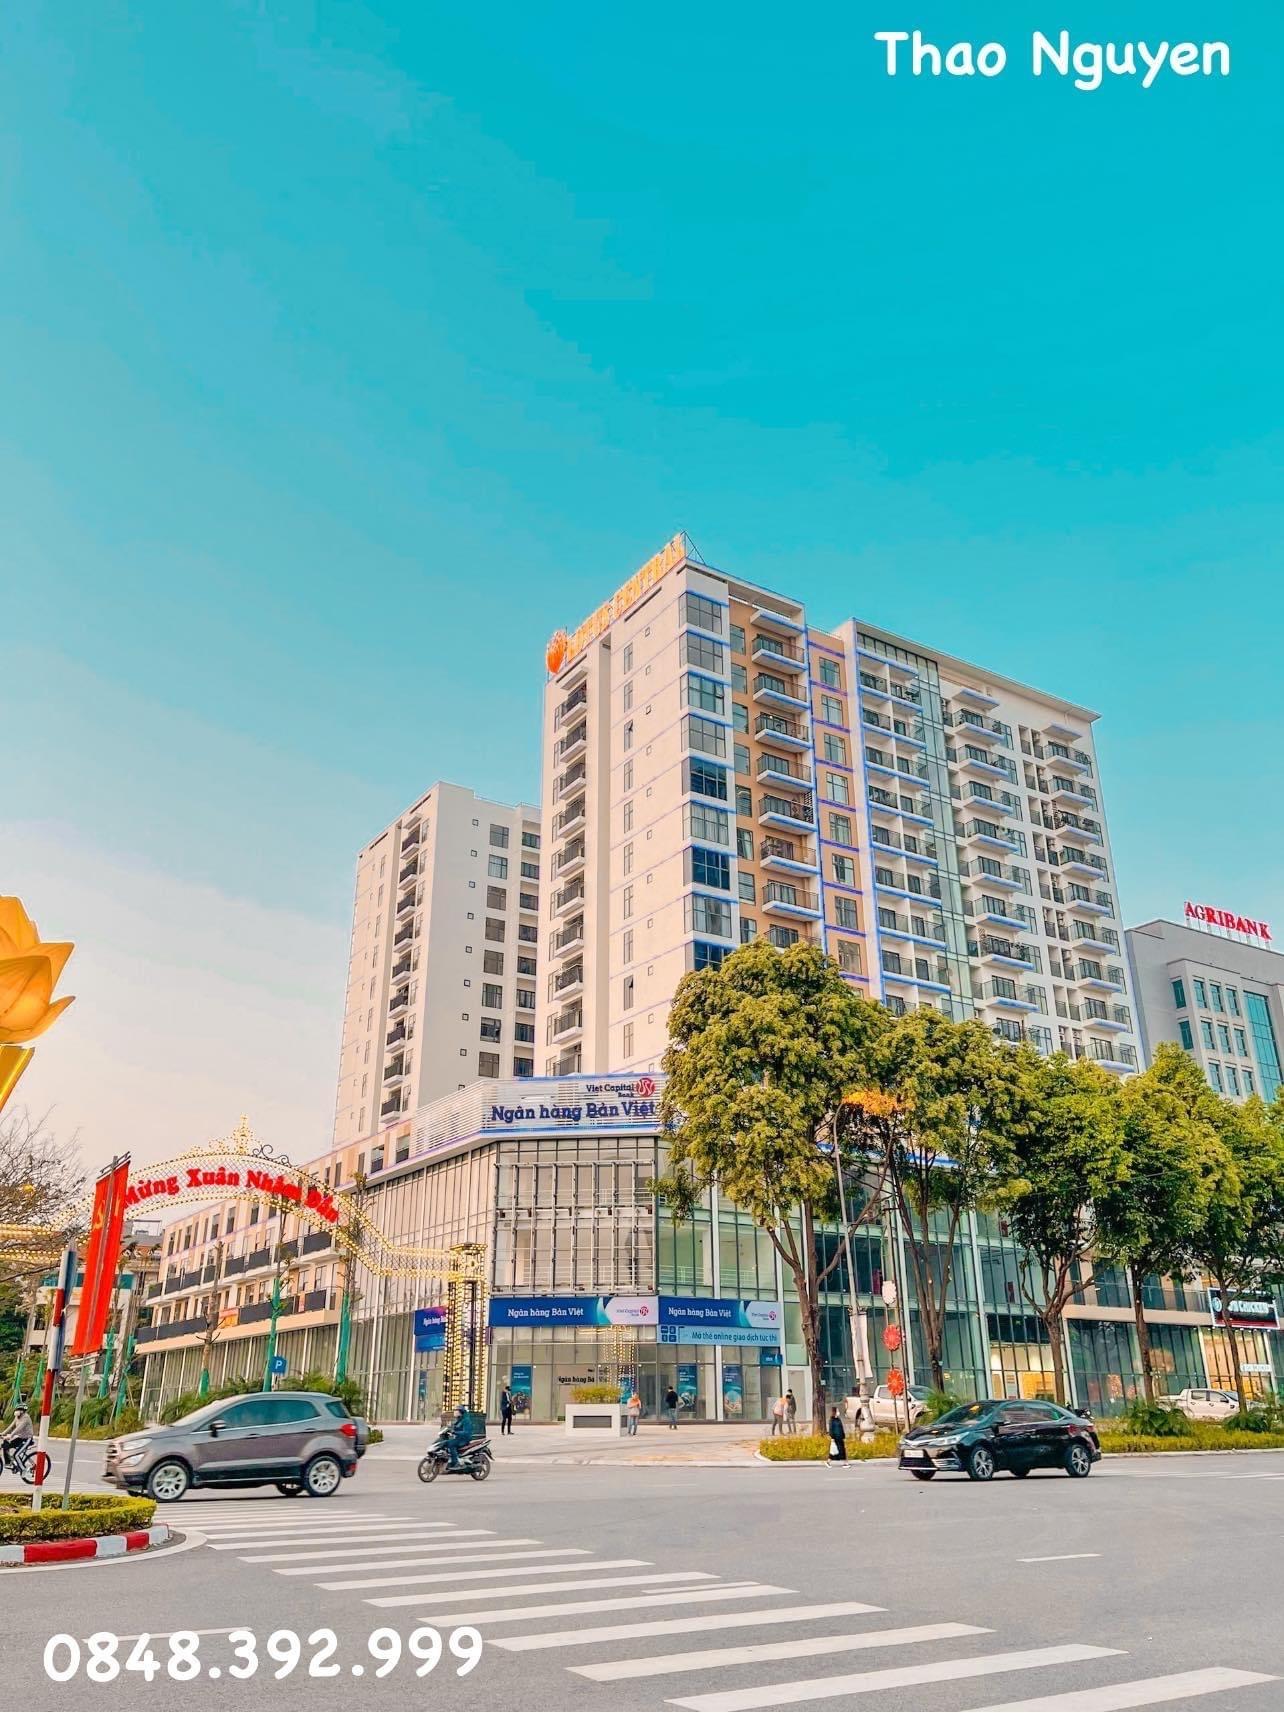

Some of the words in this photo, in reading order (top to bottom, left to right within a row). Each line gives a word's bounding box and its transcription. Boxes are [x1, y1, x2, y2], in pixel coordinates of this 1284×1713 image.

[1184, 901, 1272, 940] AGRIBANK
[604, 1083, 634, 1093] Capital
[491, 1105, 535, 1124] Ngân
[539, 1104, 582, 1122] hàng
[586, 1102, 619, 1118] Bản
[621, 1101, 656, 1119] Việt
[186, 1166, 239, 1188] Xuân
[507, 1308, 528, 1318] Ngân
[530, 1308, 550, 1318] hàng
[551, 1307, 567, 1316] Bản
[568, 1307, 584, 1317] Việt
[668, 1307, 686, 1317] Ngân
[687, 1307, 704, 1318] hàng
[719, 1309, 732, 1318] Việt
[275, 1360, 283, 1370] P
